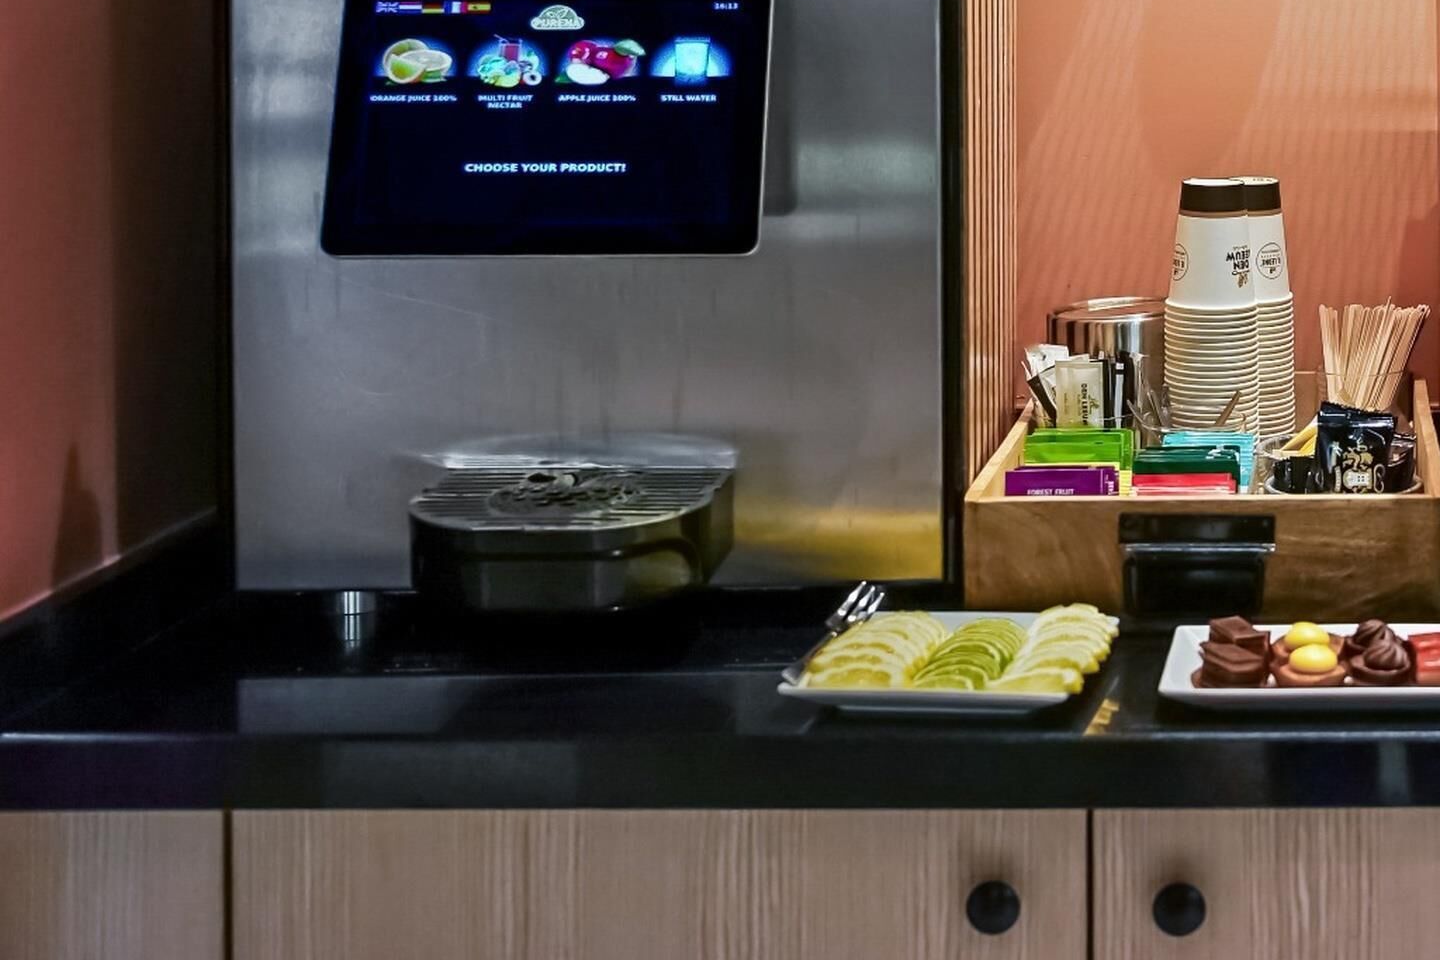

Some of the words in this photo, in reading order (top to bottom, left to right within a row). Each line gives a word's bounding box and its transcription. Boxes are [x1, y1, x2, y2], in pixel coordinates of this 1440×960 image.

[370, 94, 407, 102] ORANGE
[477, 94, 505, 102] MULTI
[506, 94, 533, 102] FRUIT
[558, 94, 586, 102] APPLE
[586, 94, 611, 103] JUICE
[660, 94, 685, 102] STILL
[685, 94, 717, 102] WATER
[464, 162, 518, 173] CHOOSE
[520, 162, 558, 173] YOUR
[559, 162, 627, 173] PRODUCT!
